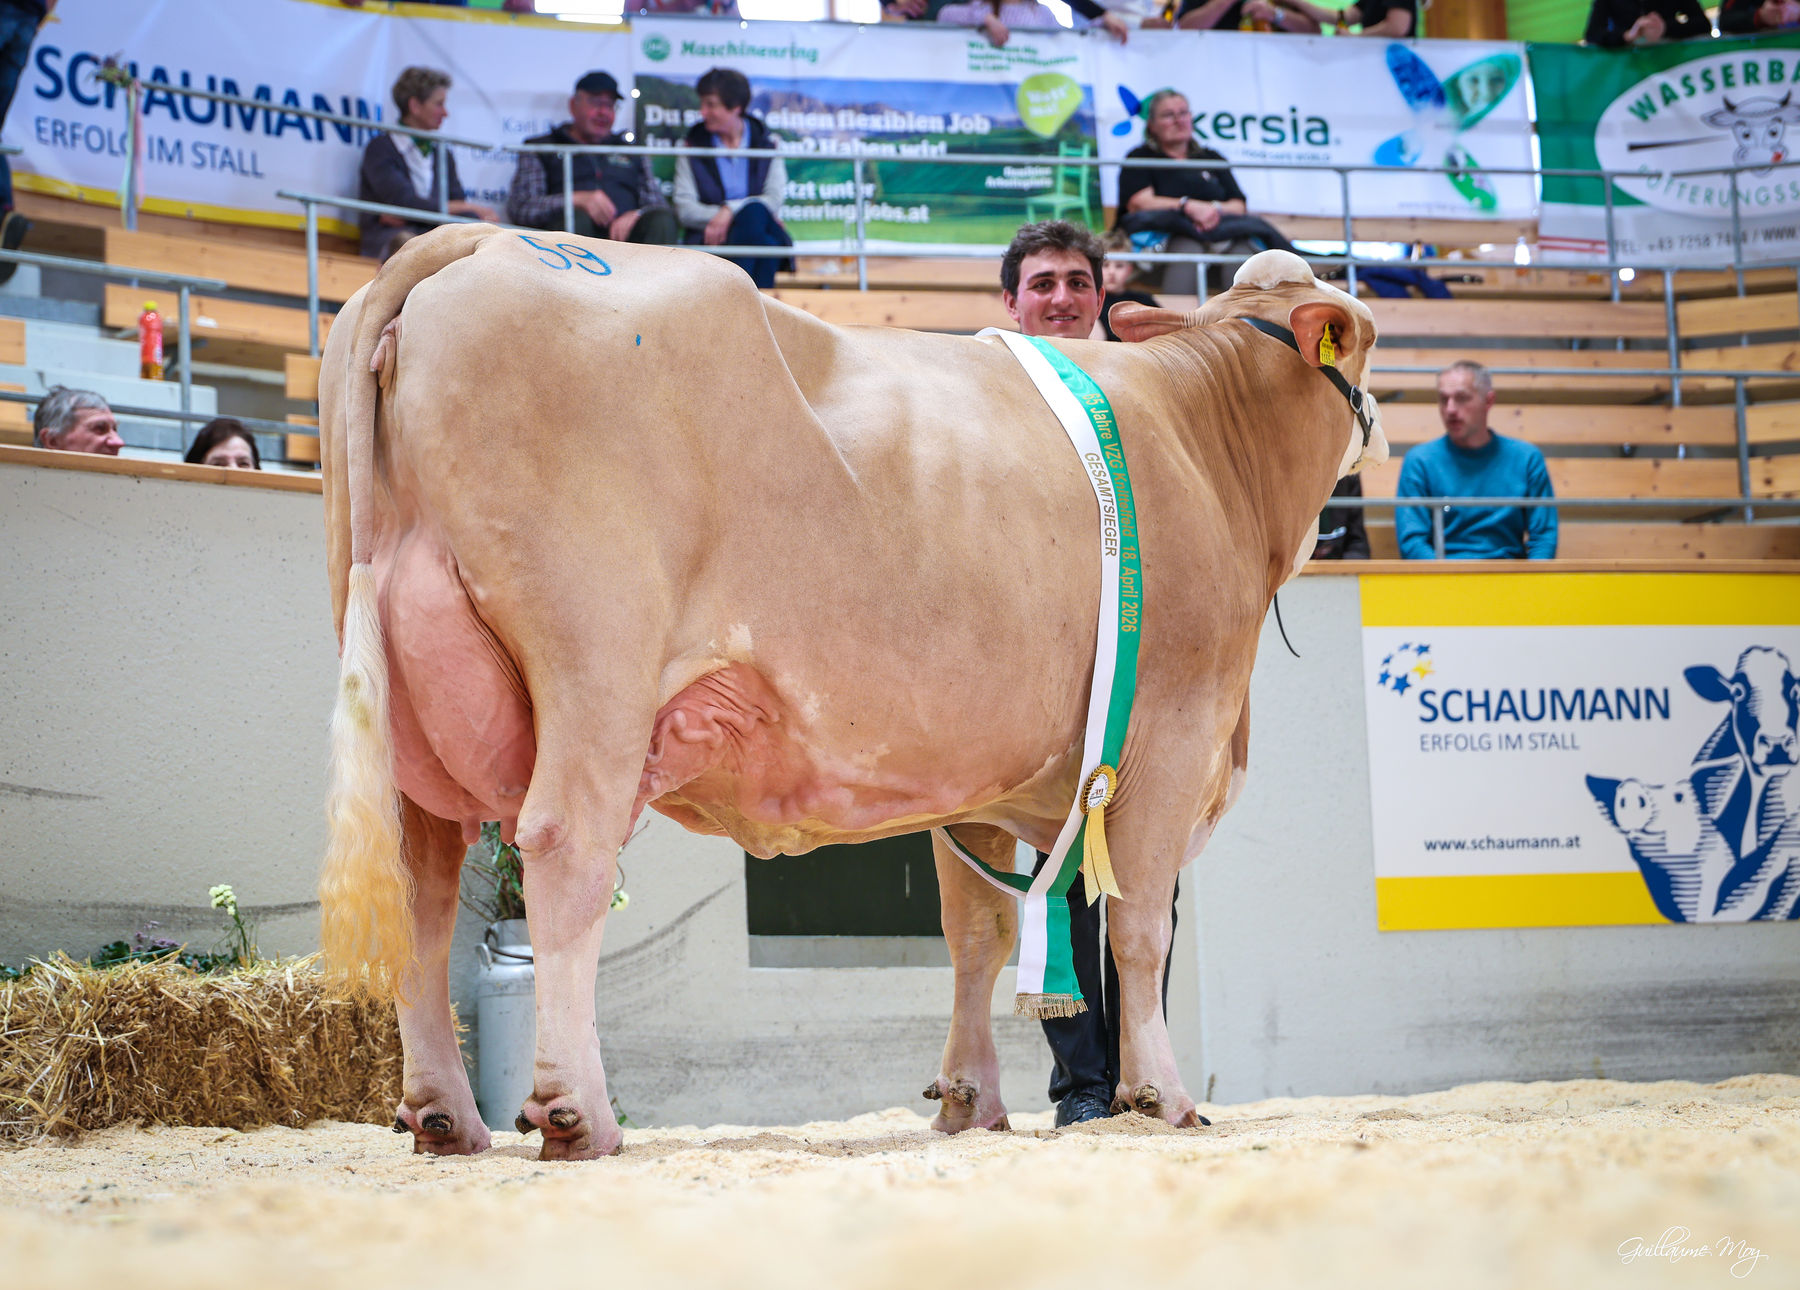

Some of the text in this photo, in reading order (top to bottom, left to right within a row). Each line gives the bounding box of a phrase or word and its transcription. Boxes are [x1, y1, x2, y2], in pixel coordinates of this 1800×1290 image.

[681, 40, 819, 64] Maschinenring
[645, 105, 682, 127] Du
[765, 108, 835, 131] einen
[836, 109, 946, 133] flexiblen
[947, 112, 992, 135] Job
[148, 136, 184, 166] IM
[191, 140, 265, 179] STALL
[517, 234, 613, 276] 59
[1082, 393, 1139, 633] 65 Jahre VZG Knittelfeld 18. April 2026
[1084, 452, 1118, 557] GESAMTSIEGER
[1418, 687, 1671, 723] SCHAUMANN
[1419, 732, 1581, 752] ERFOLG IM STALL
[1424, 834, 1582, 852] www.schaumann.at
